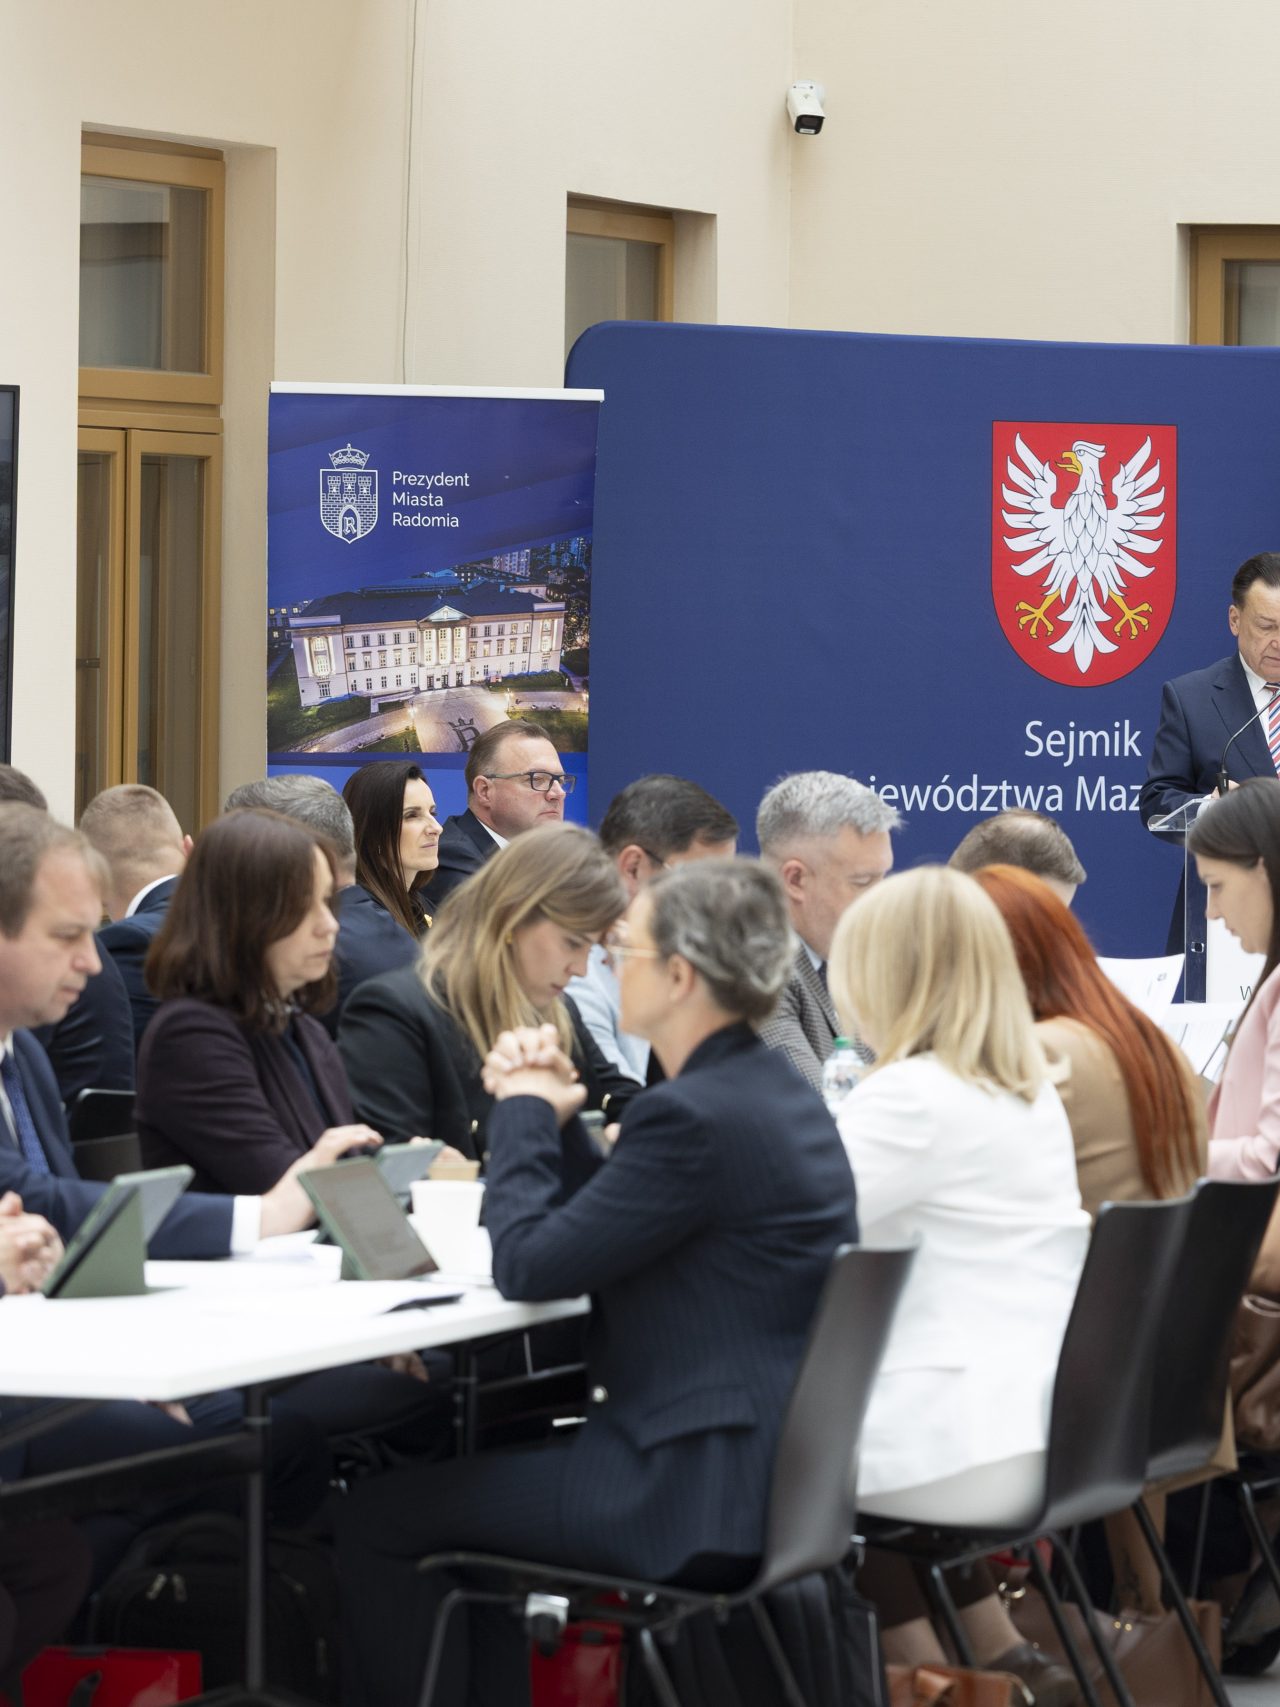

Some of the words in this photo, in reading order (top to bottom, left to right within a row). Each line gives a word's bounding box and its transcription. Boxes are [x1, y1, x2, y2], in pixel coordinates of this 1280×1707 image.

[393, 471, 470, 490] Prezydent
[393, 491, 444, 507] Miasta
[392, 512, 460, 527] Radomia
[1024, 719, 1142, 767] Sejmik
[869, 773, 1063, 812] ewództwa
[1075, 775, 1143, 812] Maz
